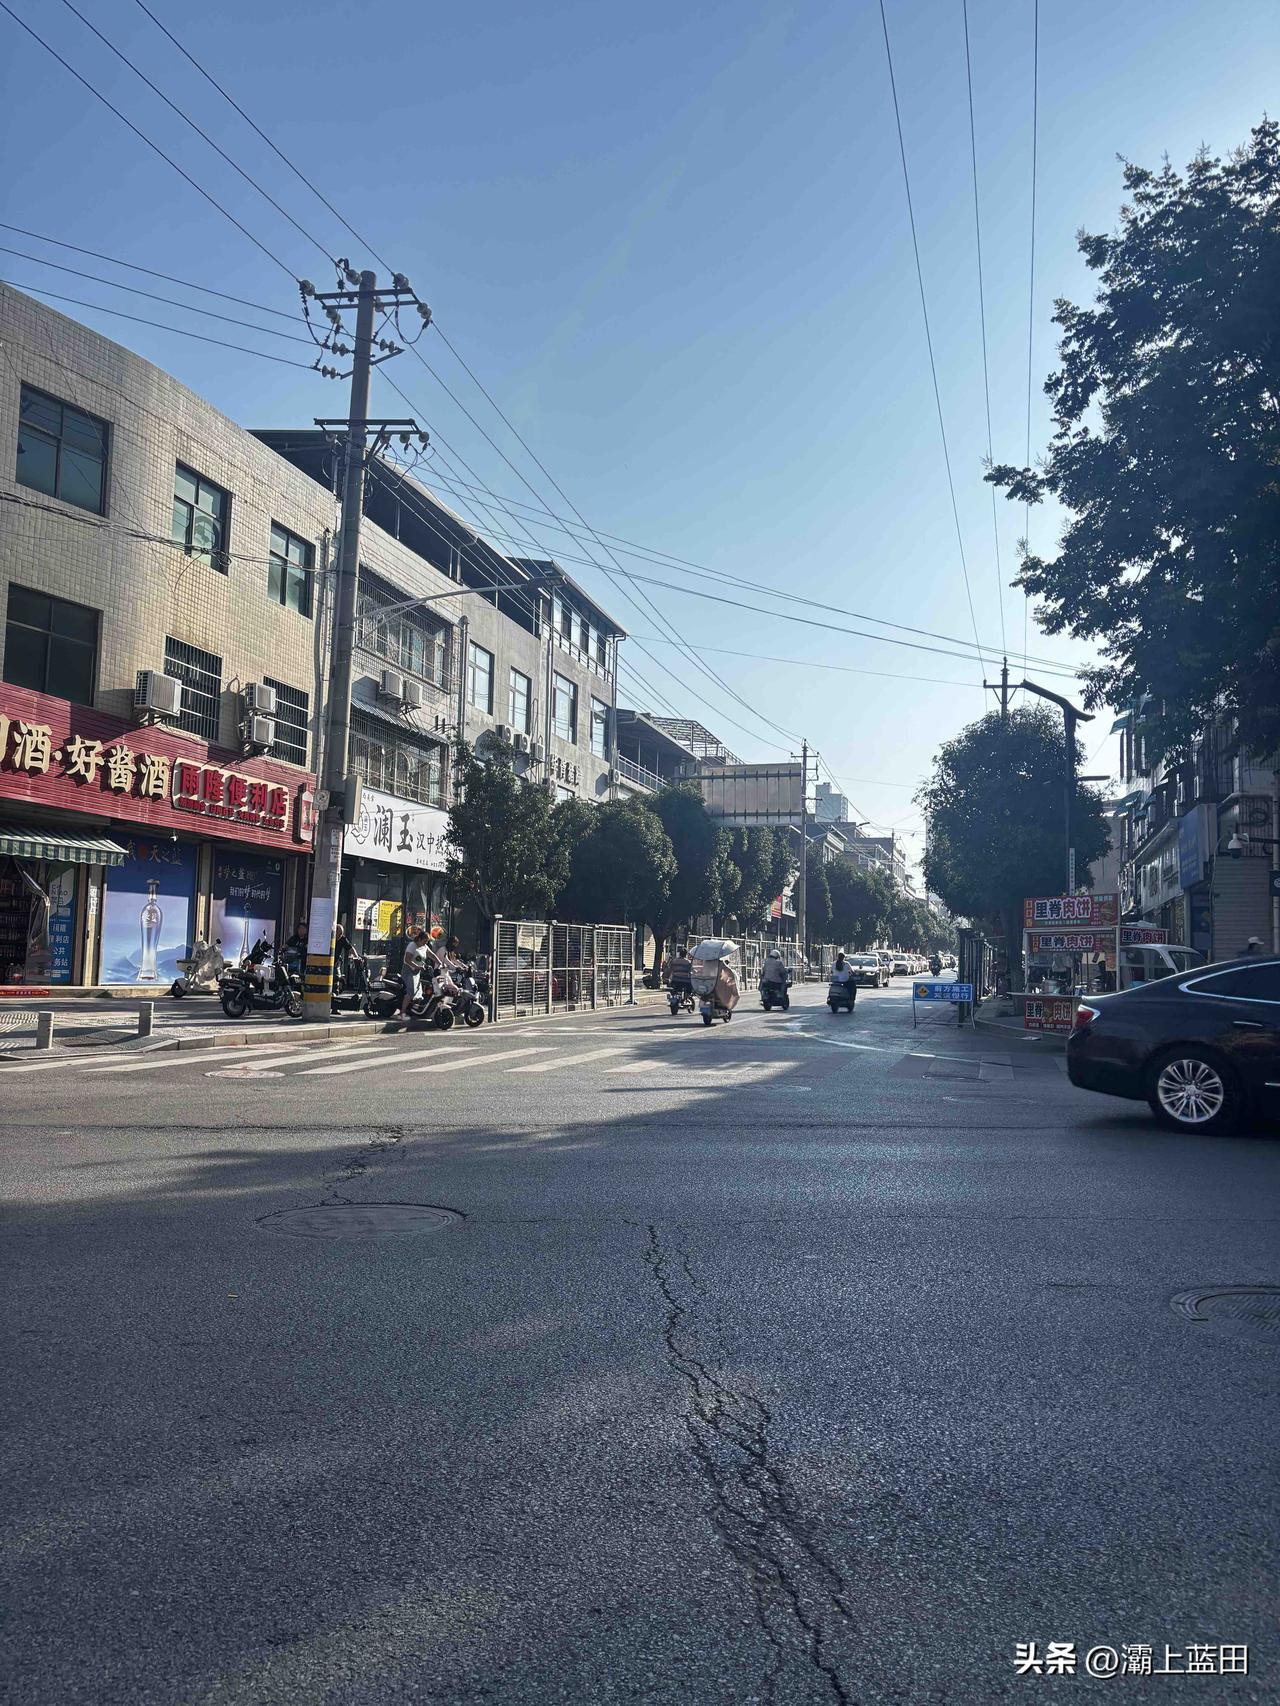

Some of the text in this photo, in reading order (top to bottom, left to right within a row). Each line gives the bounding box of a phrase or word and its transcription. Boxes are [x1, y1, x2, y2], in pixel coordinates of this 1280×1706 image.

[181, 763, 288, 816] 雨隆便利店
[373, 804, 414, 854] 澜玉
[1034, 897, 1092, 920] 里脊肉饼
[1040, 934, 1094, 948] 里脊肉饼
[1121, 929, 1166, 944] 里脊肉饼
[1026, 1001, 1071, 1020] 里脊 肉饼
